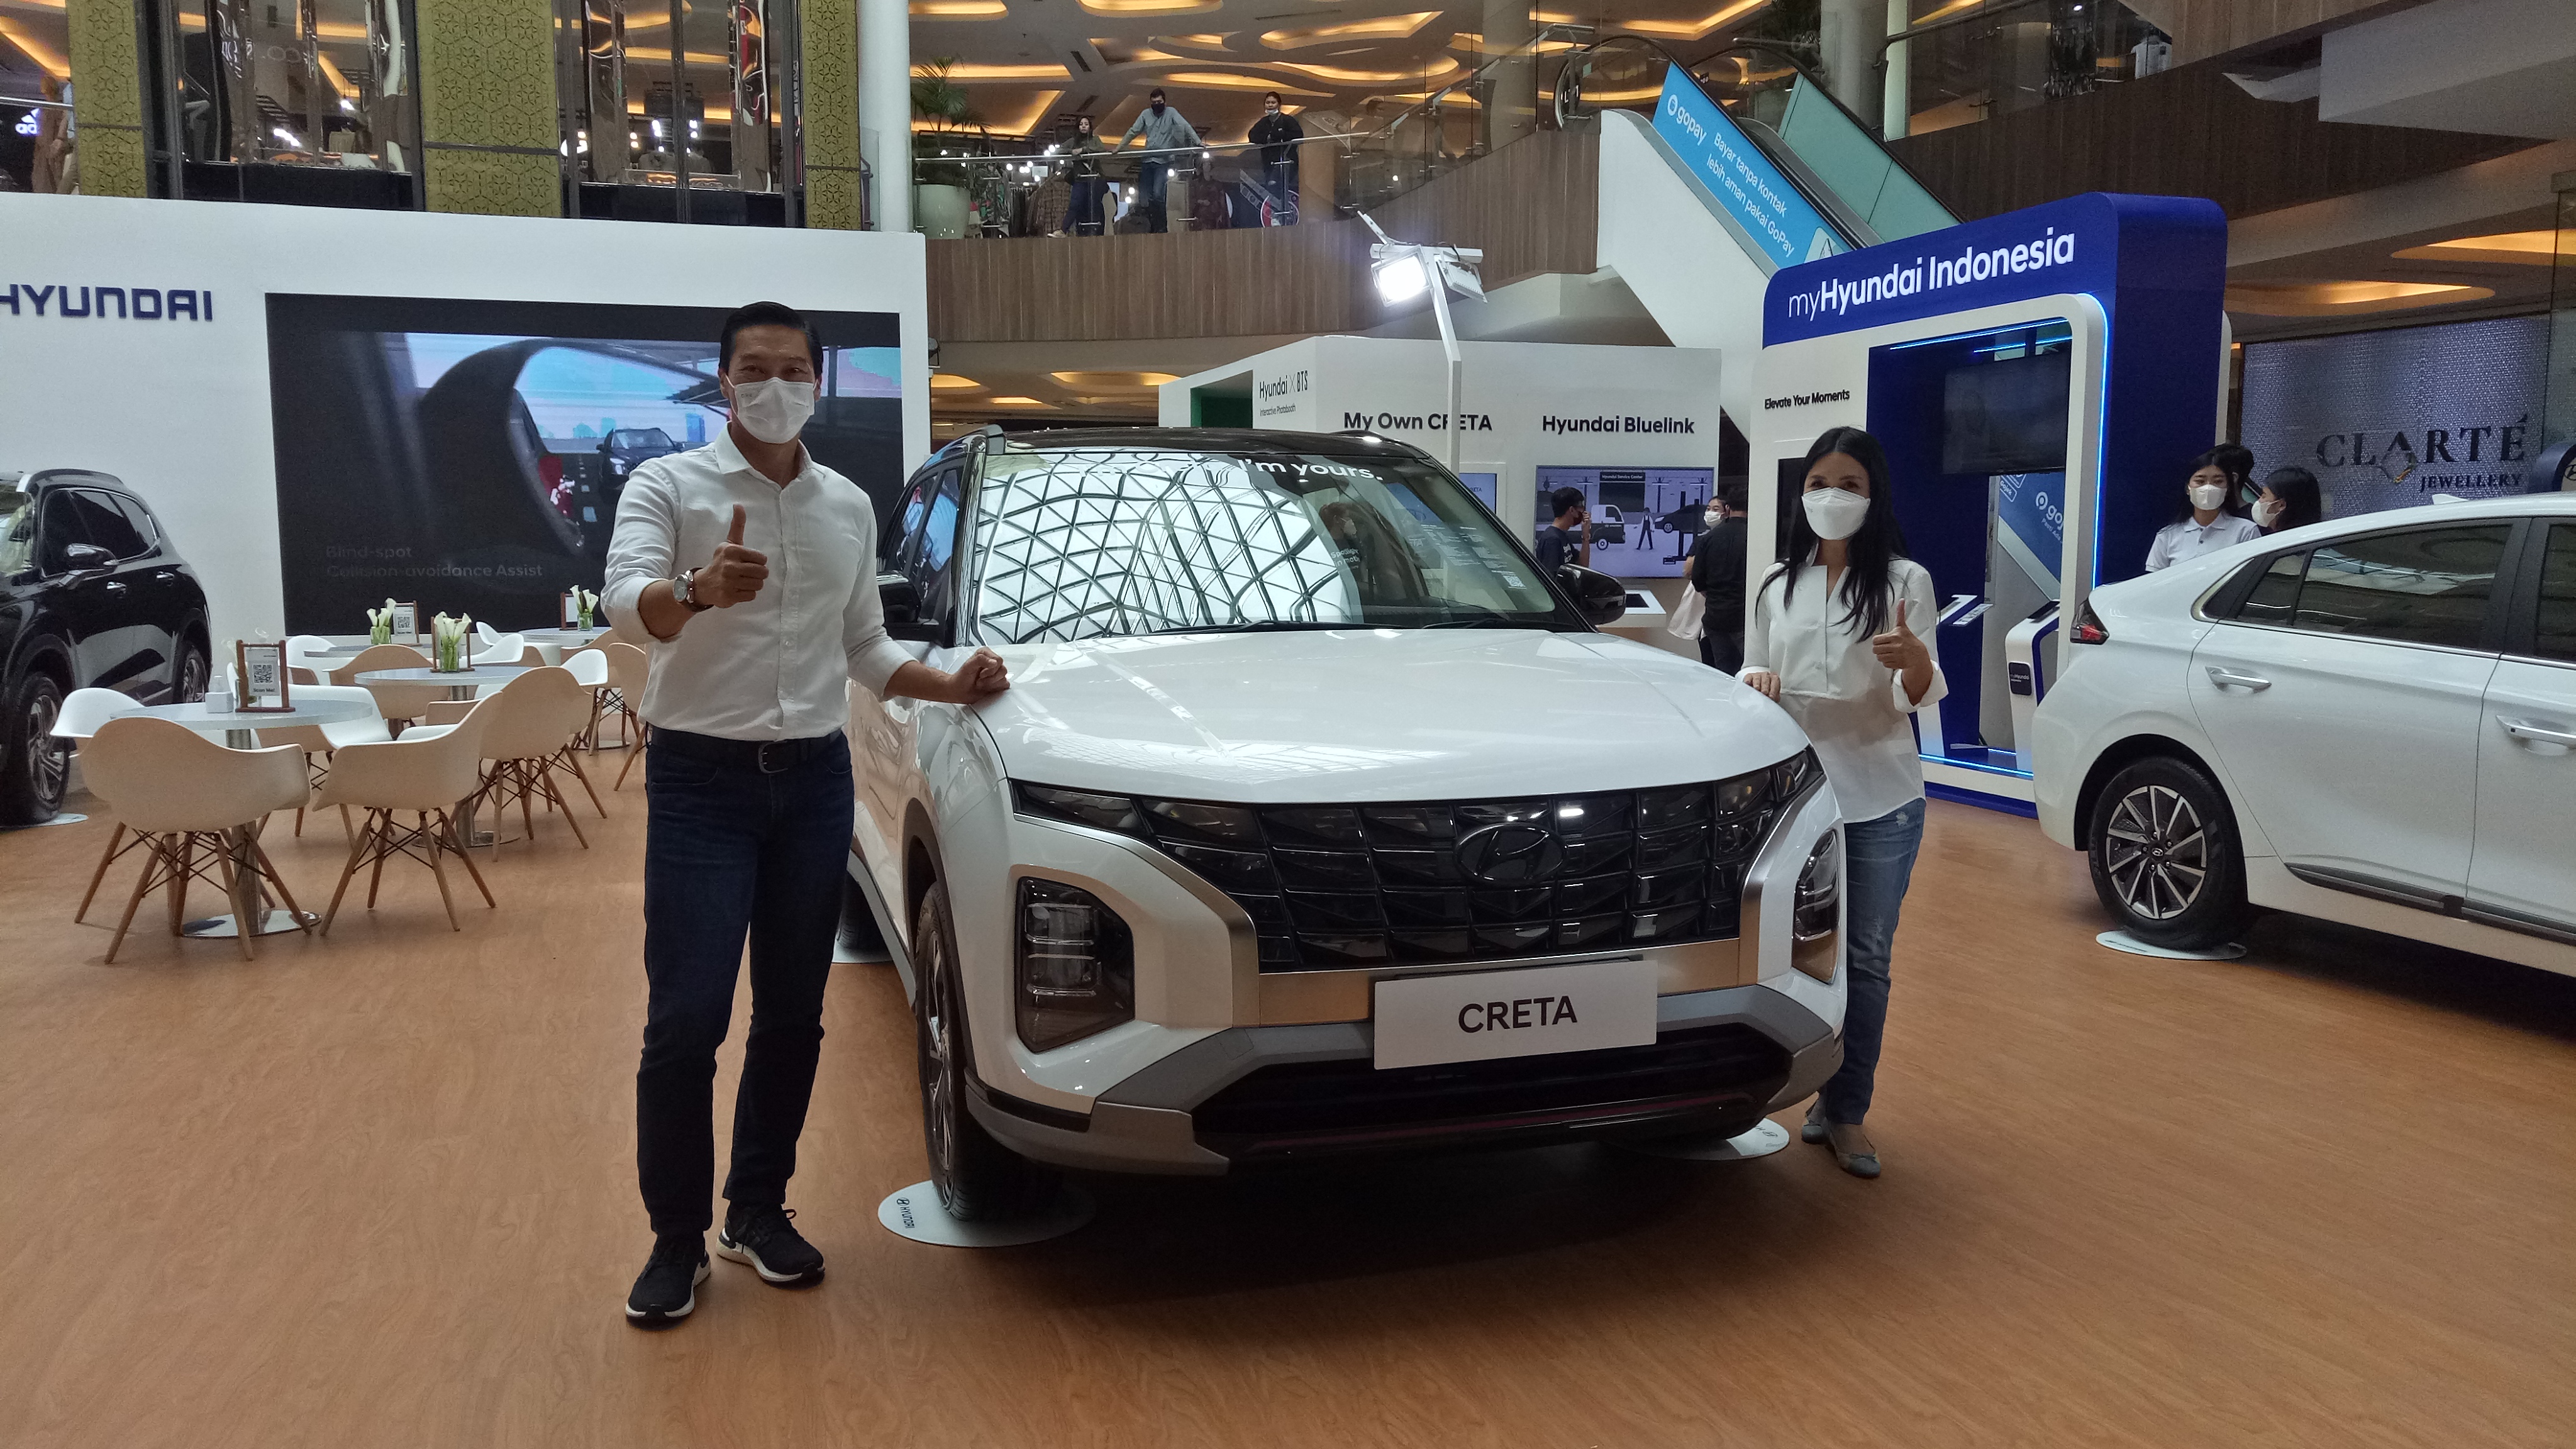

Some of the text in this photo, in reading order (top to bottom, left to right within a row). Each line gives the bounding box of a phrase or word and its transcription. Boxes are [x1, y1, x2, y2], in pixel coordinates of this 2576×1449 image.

[1676, 106, 1707, 146] gopay
[1714, 133, 1787, 218] Bayar tanpa kontak
[1707, 153, 1795, 258] lebih aman pakai GoPay
[1788, 226, 2075, 321] myHyundai Indonesia
[0, 284, 213, 321] HYUNDAI
[1259, 375, 1287, 402] Hyundai
[1297, 370, 1308, 392] BTS
[1764, 389, 1850, 409] Elevate Your Moments
[1344, 412, 1374, 431] My
[1377, 412, 1423, 430] Own
[1542, 415, 1695, 435] Hyundai Bluelink
[1291, 463, 1384, 480] yours.
[2421, 474, 2523, 492] JEWELLERY
[495, 564, 543, 577] Assist
[1458, 995, 1578, 1033] CRETA
[899, 1206, 915, 1229] HYUNDAI
